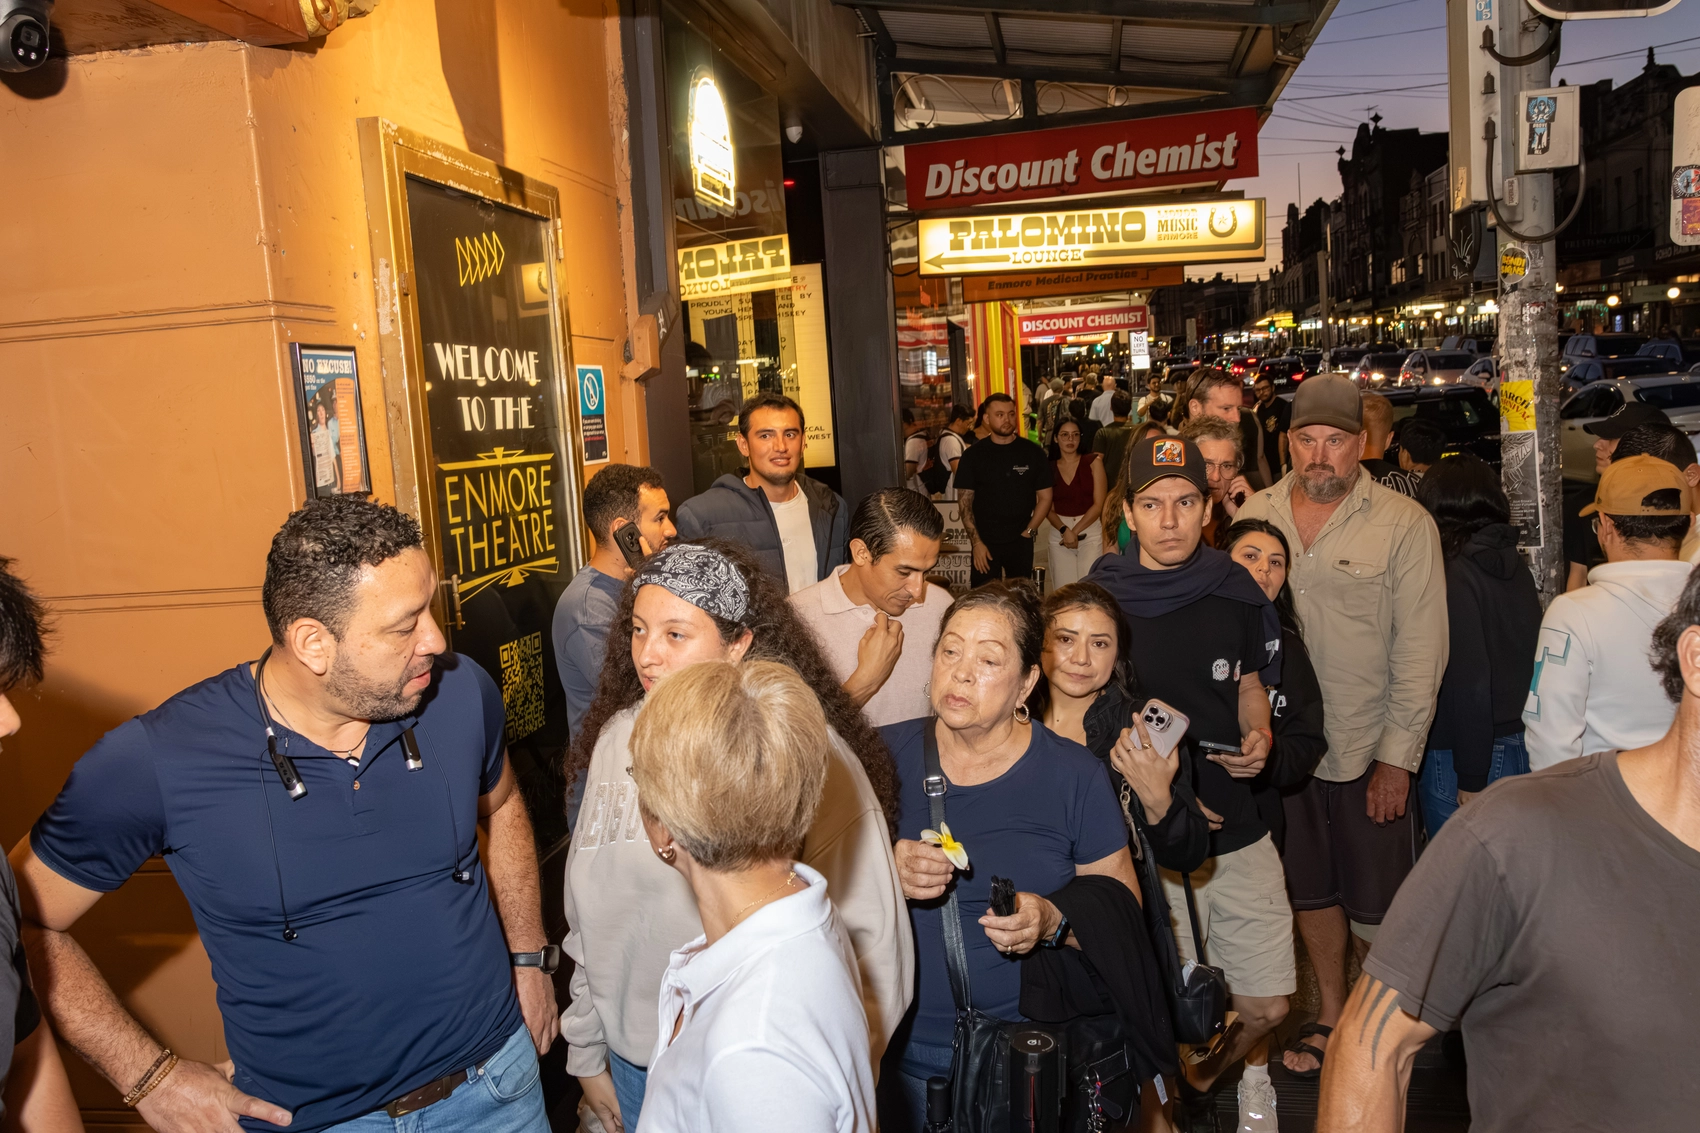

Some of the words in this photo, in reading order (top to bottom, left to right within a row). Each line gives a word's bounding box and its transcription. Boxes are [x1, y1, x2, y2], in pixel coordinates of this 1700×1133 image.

[925, 149, 1079, 197] Discount
[1091, 132, 1238, 180] Chemist
[1157, 208, 1198, 217] LIQUOR
[949, 211, 1146, 251] PALOMINO
[1157, 218, 1198, 233] MUSIC
[1157, 232, 1199, 241] ENMORE
[1012, 249, 1082, 264] LOUNGE
[988, 280, 1032, 290] Enmore
[1036, 273, 1083, 286] Medical
[1086, 270, 1138, 281] Practice
[691, 300, 731, 308] PROUDLY
[704, 308, 732, 316] YOUNG
[1022, 316, 1085, 332] DISCOUNT
[1087, 312, 1143, 327] CHEMIST
[302, 358, 315, 373] NO
[433, 342, 541, 383] WELCOME
[1501, 389, 1530, 409] ARCH
[457, 396, 486, 431] TO
[491, 396, 535, 429] THE
[445, 464, 552, 525] ENMORE
[450, 509, 555, 575] THEATRE
